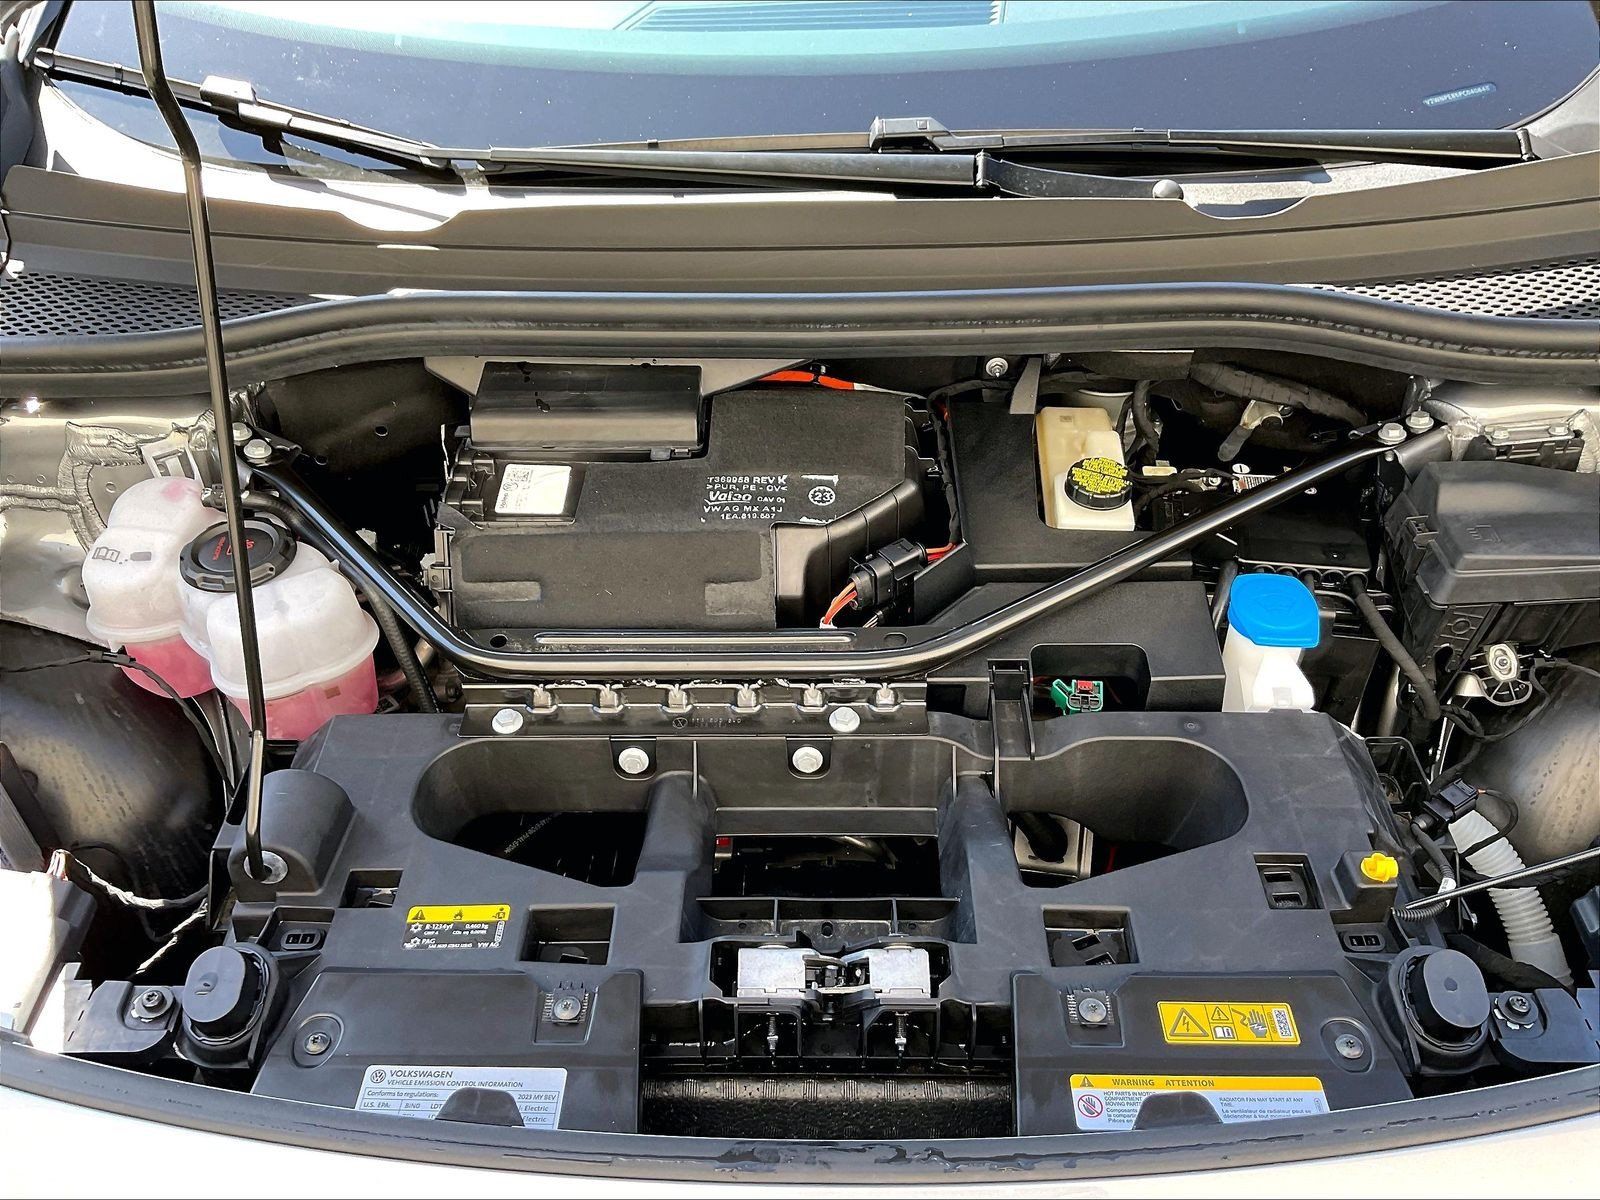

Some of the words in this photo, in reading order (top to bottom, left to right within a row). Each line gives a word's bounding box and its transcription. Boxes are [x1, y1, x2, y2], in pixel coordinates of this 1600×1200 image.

[752, 476, 776, 484] REV
[778, 474, 788, 484] K
[390, 1070, 454, 1078] VOLKSWAGEN
